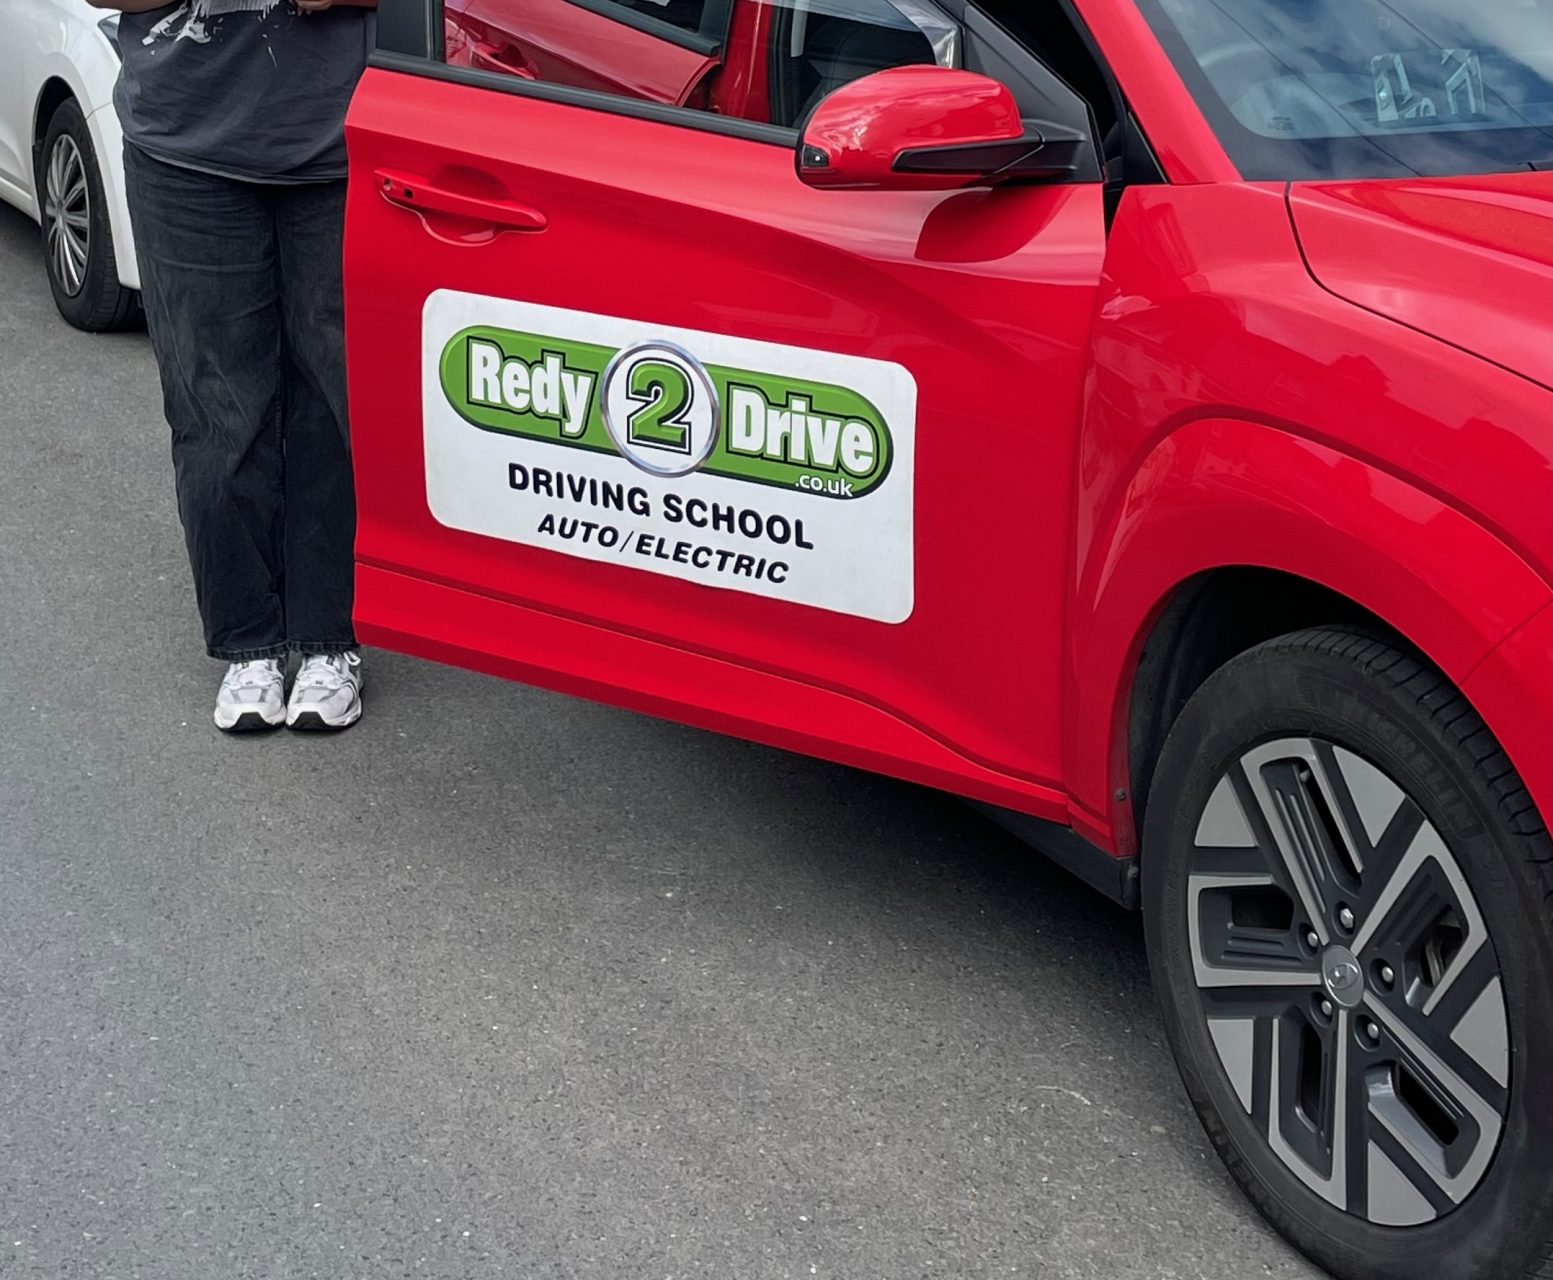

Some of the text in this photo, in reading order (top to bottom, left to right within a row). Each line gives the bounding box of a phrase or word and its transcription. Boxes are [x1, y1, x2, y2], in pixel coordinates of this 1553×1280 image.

[468, 337, 877, 474] Redy 2 Drive
[508, 462, 815, 551] DRIVING SCHOOL
[794, 473, 854, 498] .co.uk
[537, 513, 790, 584] AUTO/ELECTRIC
